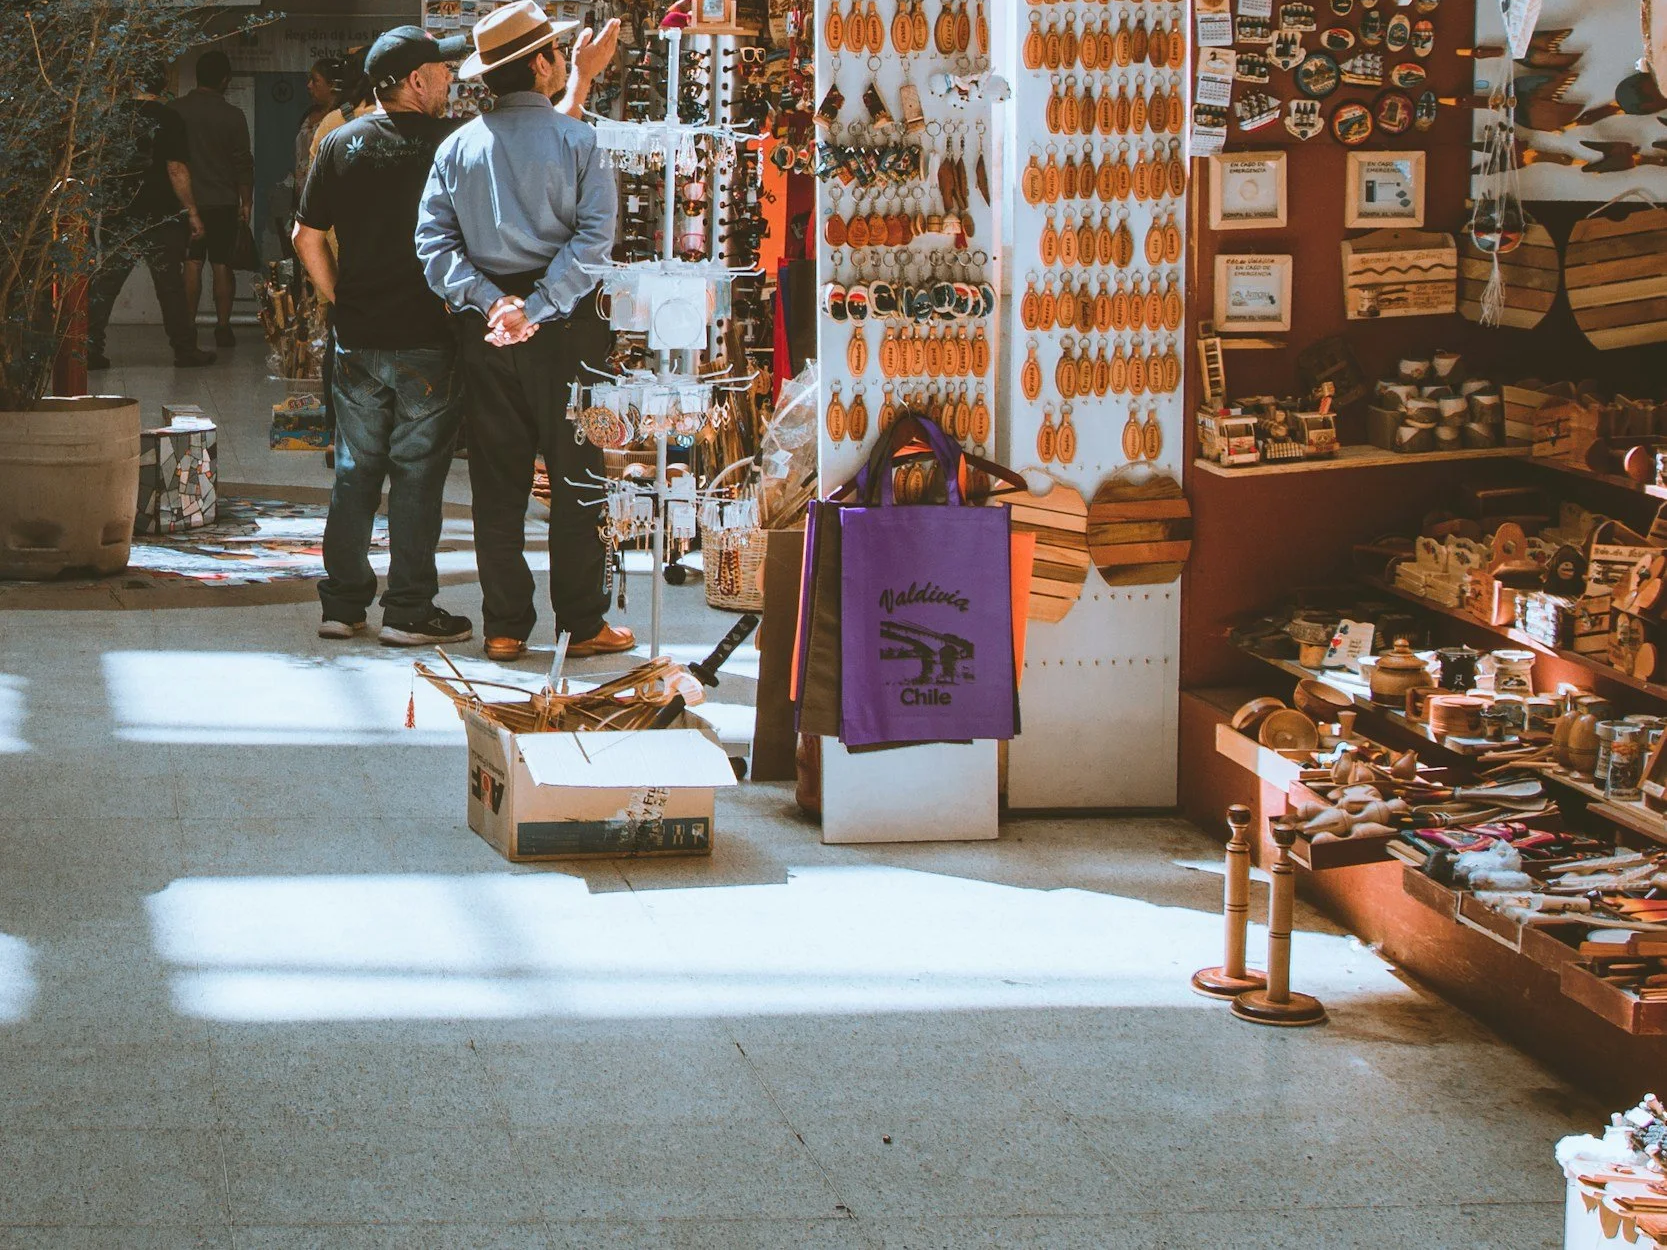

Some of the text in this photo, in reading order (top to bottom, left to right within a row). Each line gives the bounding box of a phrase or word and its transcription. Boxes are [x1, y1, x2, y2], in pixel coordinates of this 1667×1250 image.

[285, 29, 368, 43] Región de Los
[900, 688, 952, 706] Chile
